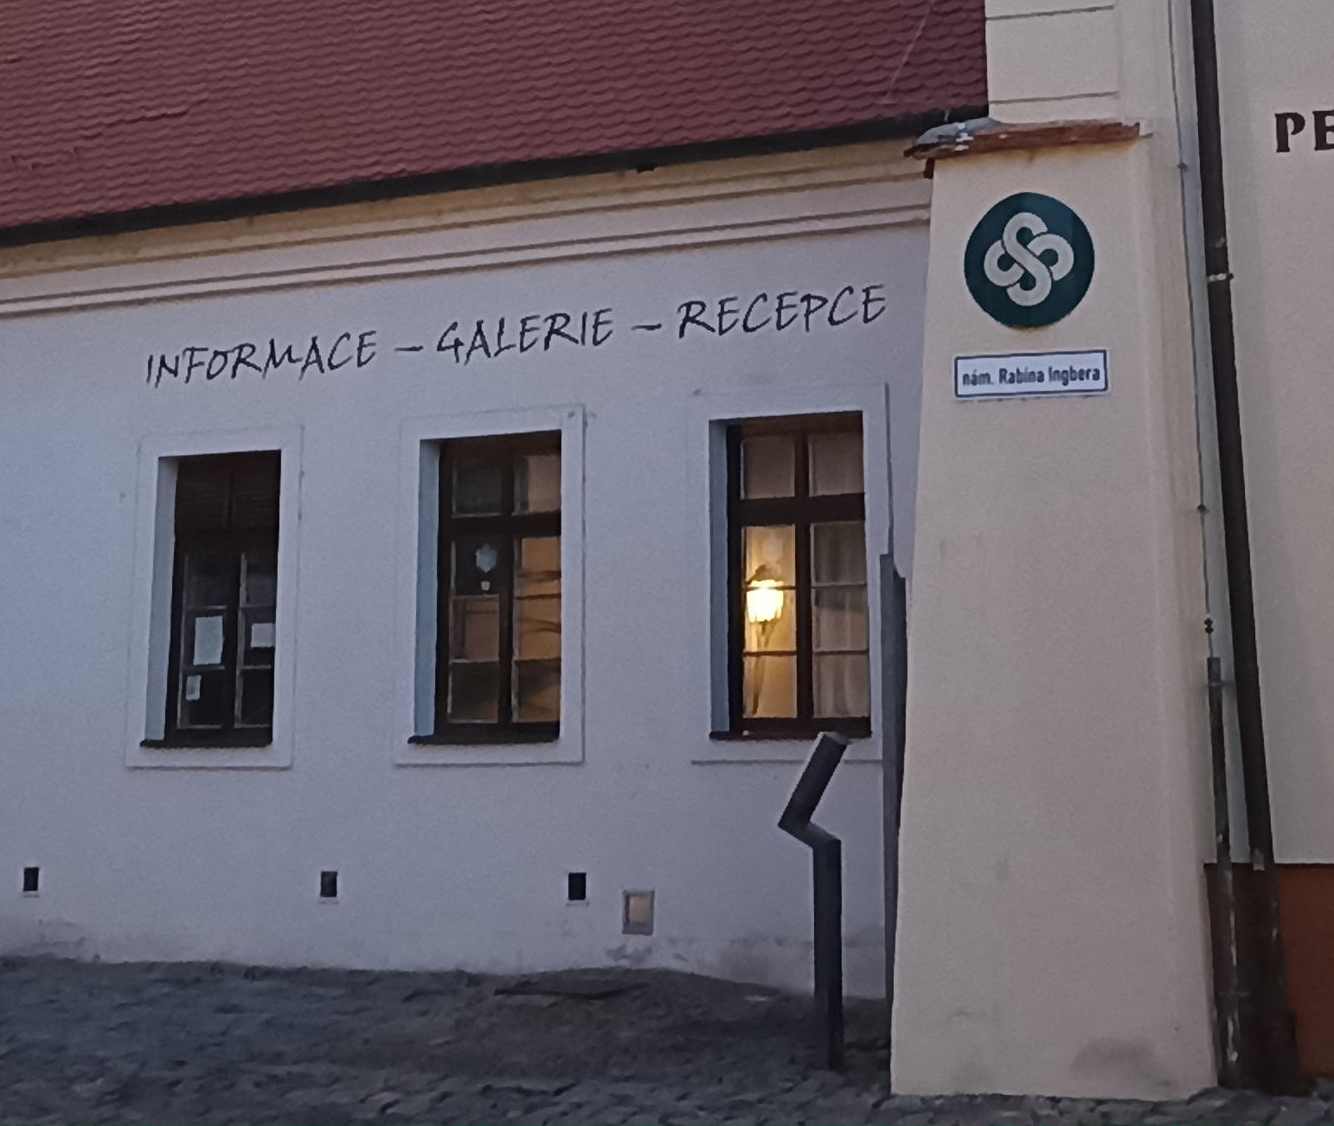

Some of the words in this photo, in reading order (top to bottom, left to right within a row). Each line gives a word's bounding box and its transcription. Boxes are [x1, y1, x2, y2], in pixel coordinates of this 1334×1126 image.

[146, 330, 377, 388] INFORMACE
[436, 307, 613, 365] GALERIE
[677, 283, 886, 339] RECEPCE
[962, 369, 995, 386] nám.
[1048, 365, 1101, 386] Ingbera
